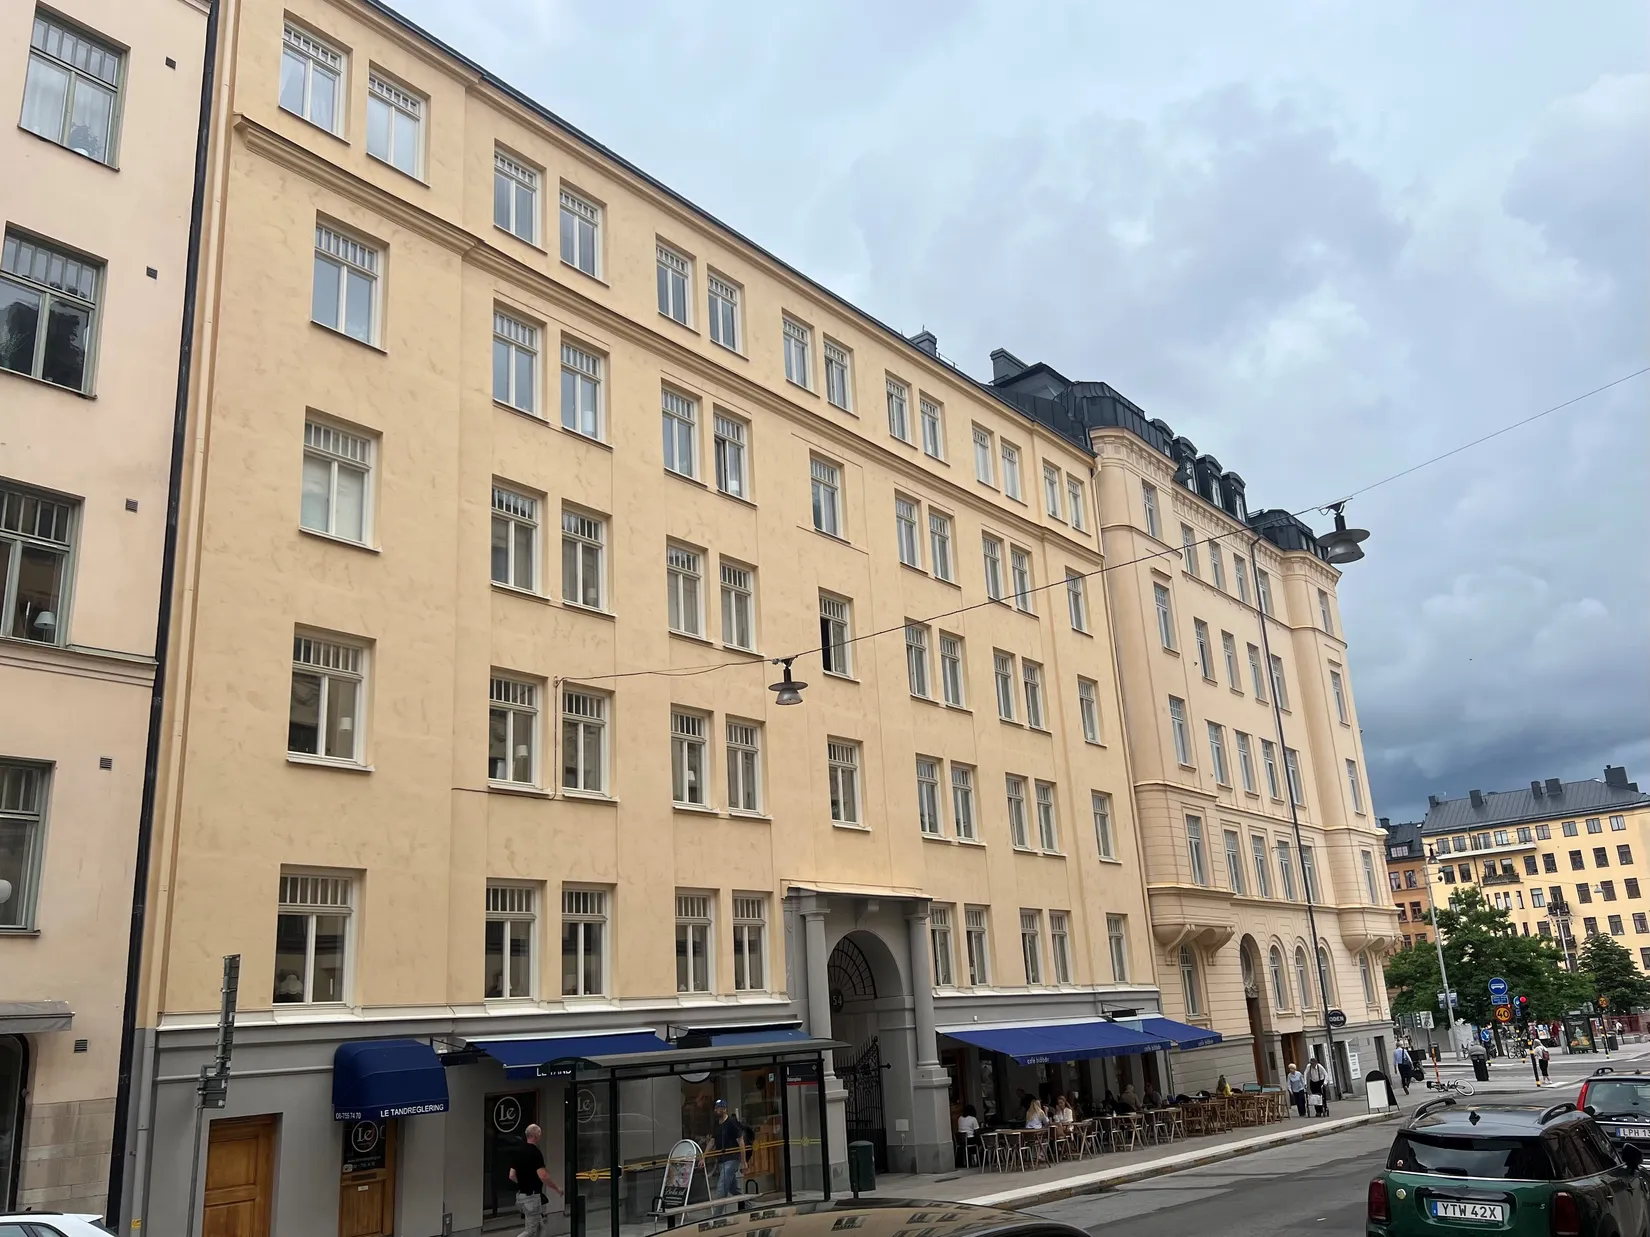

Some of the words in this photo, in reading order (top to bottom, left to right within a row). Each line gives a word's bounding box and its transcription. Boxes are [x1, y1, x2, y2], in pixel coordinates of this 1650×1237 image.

[832, 995, 843, 1006] 54
[1497, 1009, 1509, 1019] 40
[380, 1109, 389, 1118] LE
[390, 1103, 444, 1116] TANDREGLERING
[499, 1104, 516, 1121] Le
[357, 1127, 374, 1142] Le
[1622, 1129, 1640, 1137] LPH
[1441, 1203, 1467, 1217] YTW
[1471, 1206, 1497, 1219] 42X
